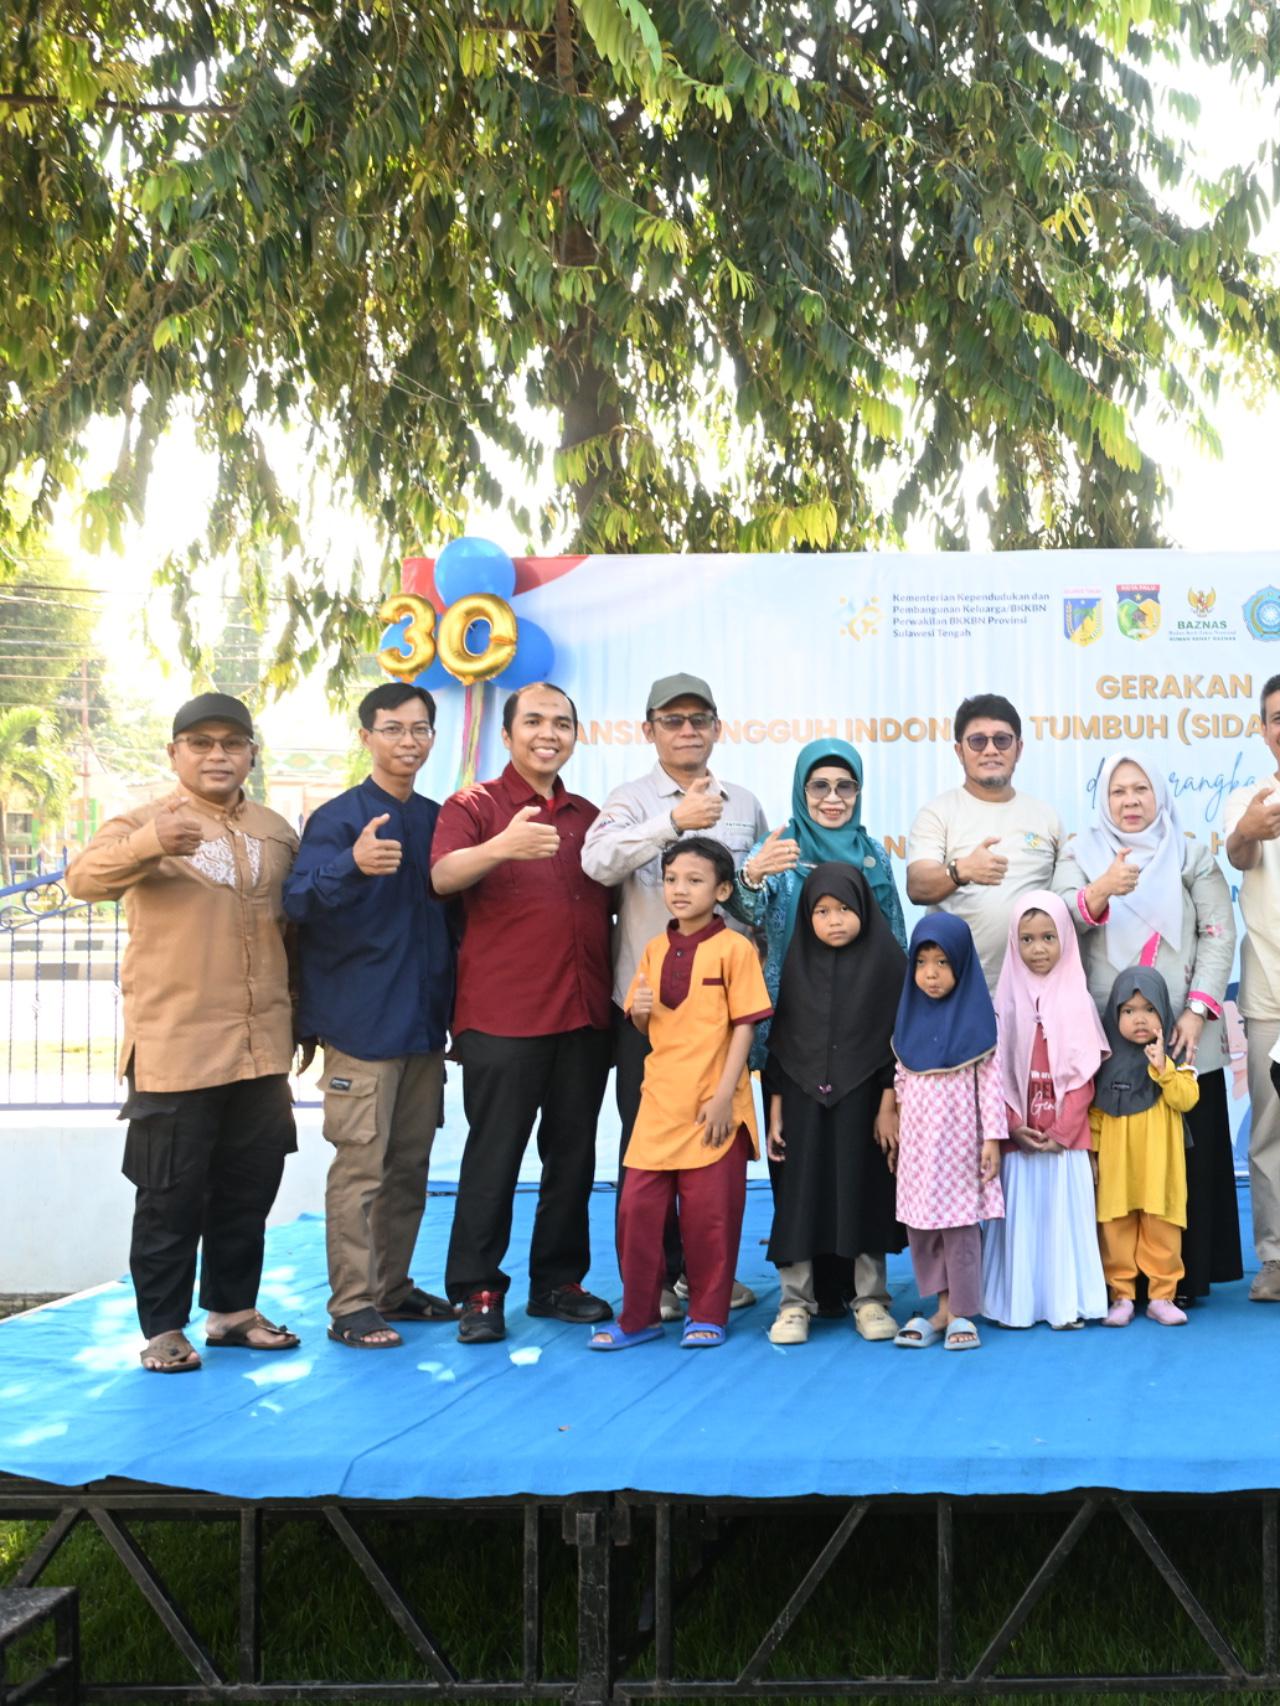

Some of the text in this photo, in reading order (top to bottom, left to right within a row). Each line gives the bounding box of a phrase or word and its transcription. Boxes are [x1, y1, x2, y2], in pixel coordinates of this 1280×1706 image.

[1177, 620, 1227, 629] BAZNAS
[377, 593, 518, 685] 30
[1096, 674, 1253, 699] GERAKAN
[845, 717, 953, 743] INDON
[1029, 714, 1168, 740] TUMBUH
